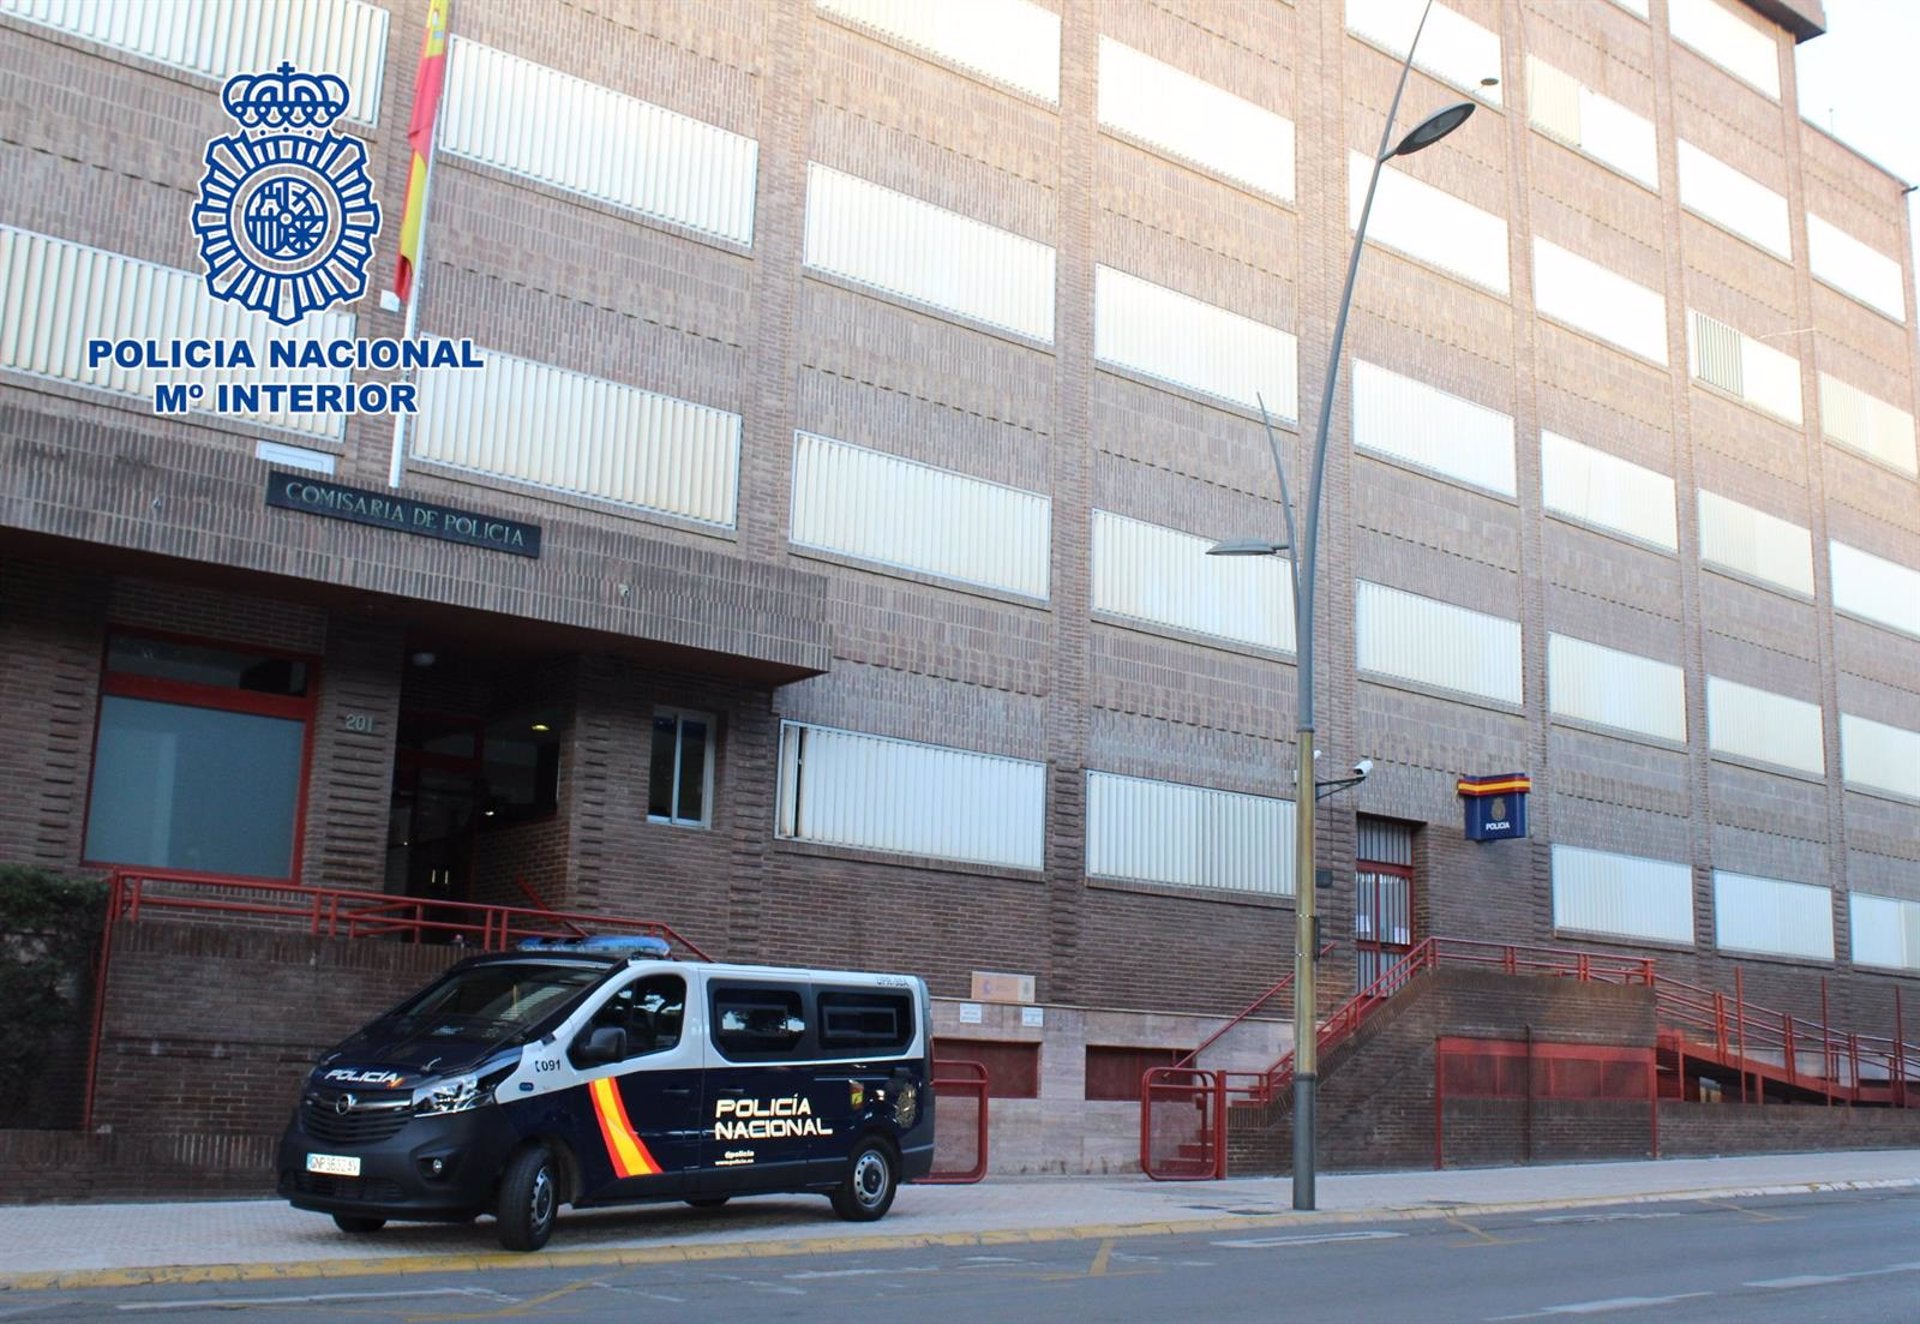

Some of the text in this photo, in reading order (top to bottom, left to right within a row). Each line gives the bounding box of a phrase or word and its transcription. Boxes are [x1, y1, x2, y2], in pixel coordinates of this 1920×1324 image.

[285, 482, 525, 547] COMISARIA DE POLICIA
[346, 714, 373, 733] 201
[541, 1059, 561, 1072] 091
[715, 1093, 811, 1118] POLICÍA
[715, 1118, 833, 1140] NACIONAL
